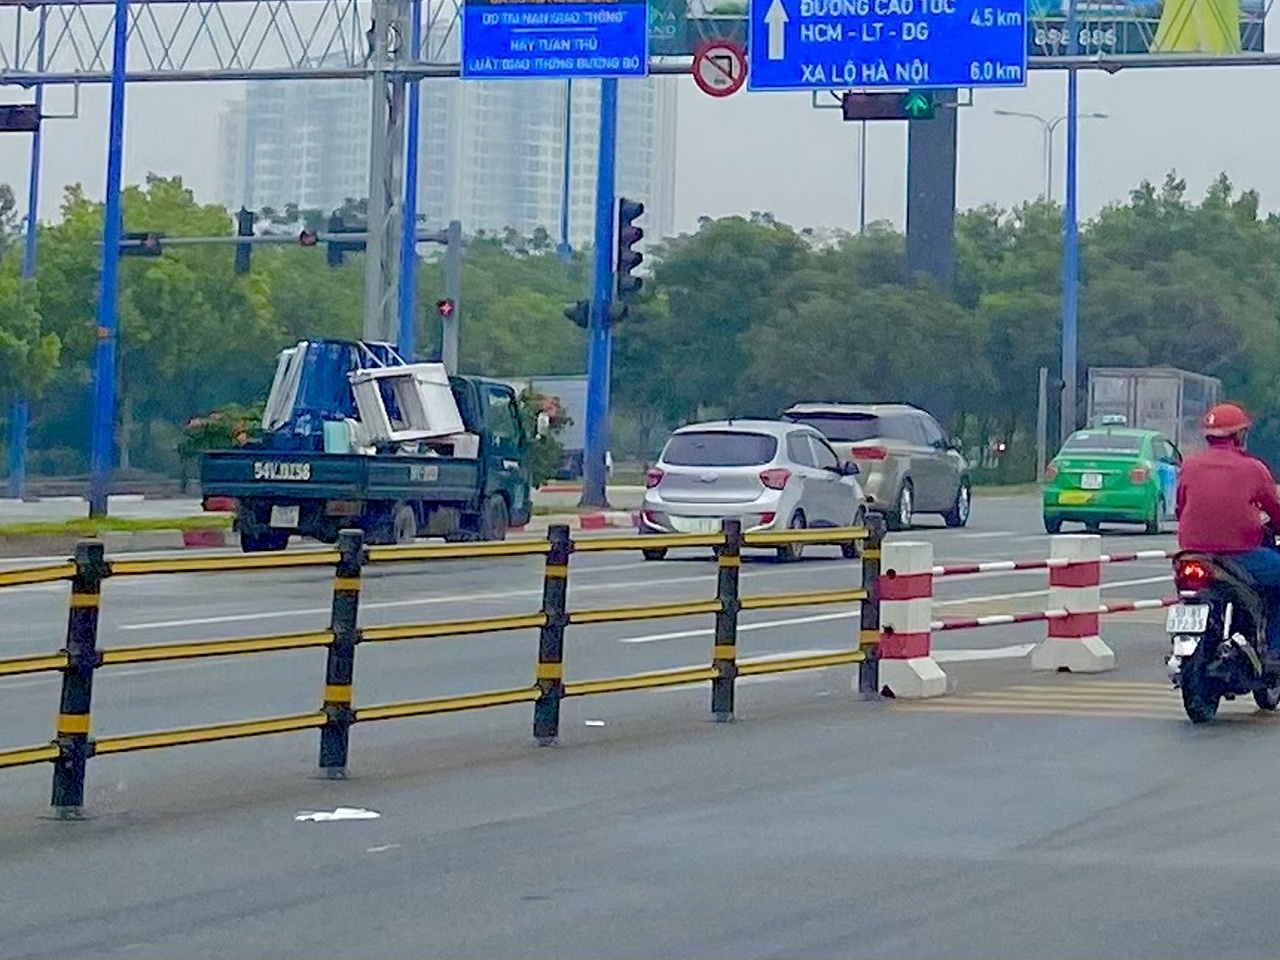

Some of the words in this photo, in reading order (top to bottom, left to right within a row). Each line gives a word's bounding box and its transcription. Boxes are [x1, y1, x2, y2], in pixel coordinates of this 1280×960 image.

[996, 8, 1022, 26] km
[800, 22, 843, 42] HCM
[862, 21, 884, 41] LT
[902, 21, 929, 41] DG
[801, 63, 826, 83] XA
[861, 58, 889, 82] HÀ
[895, 58, 930, 84] NỘI
[996, 62, 1022, 80] km
